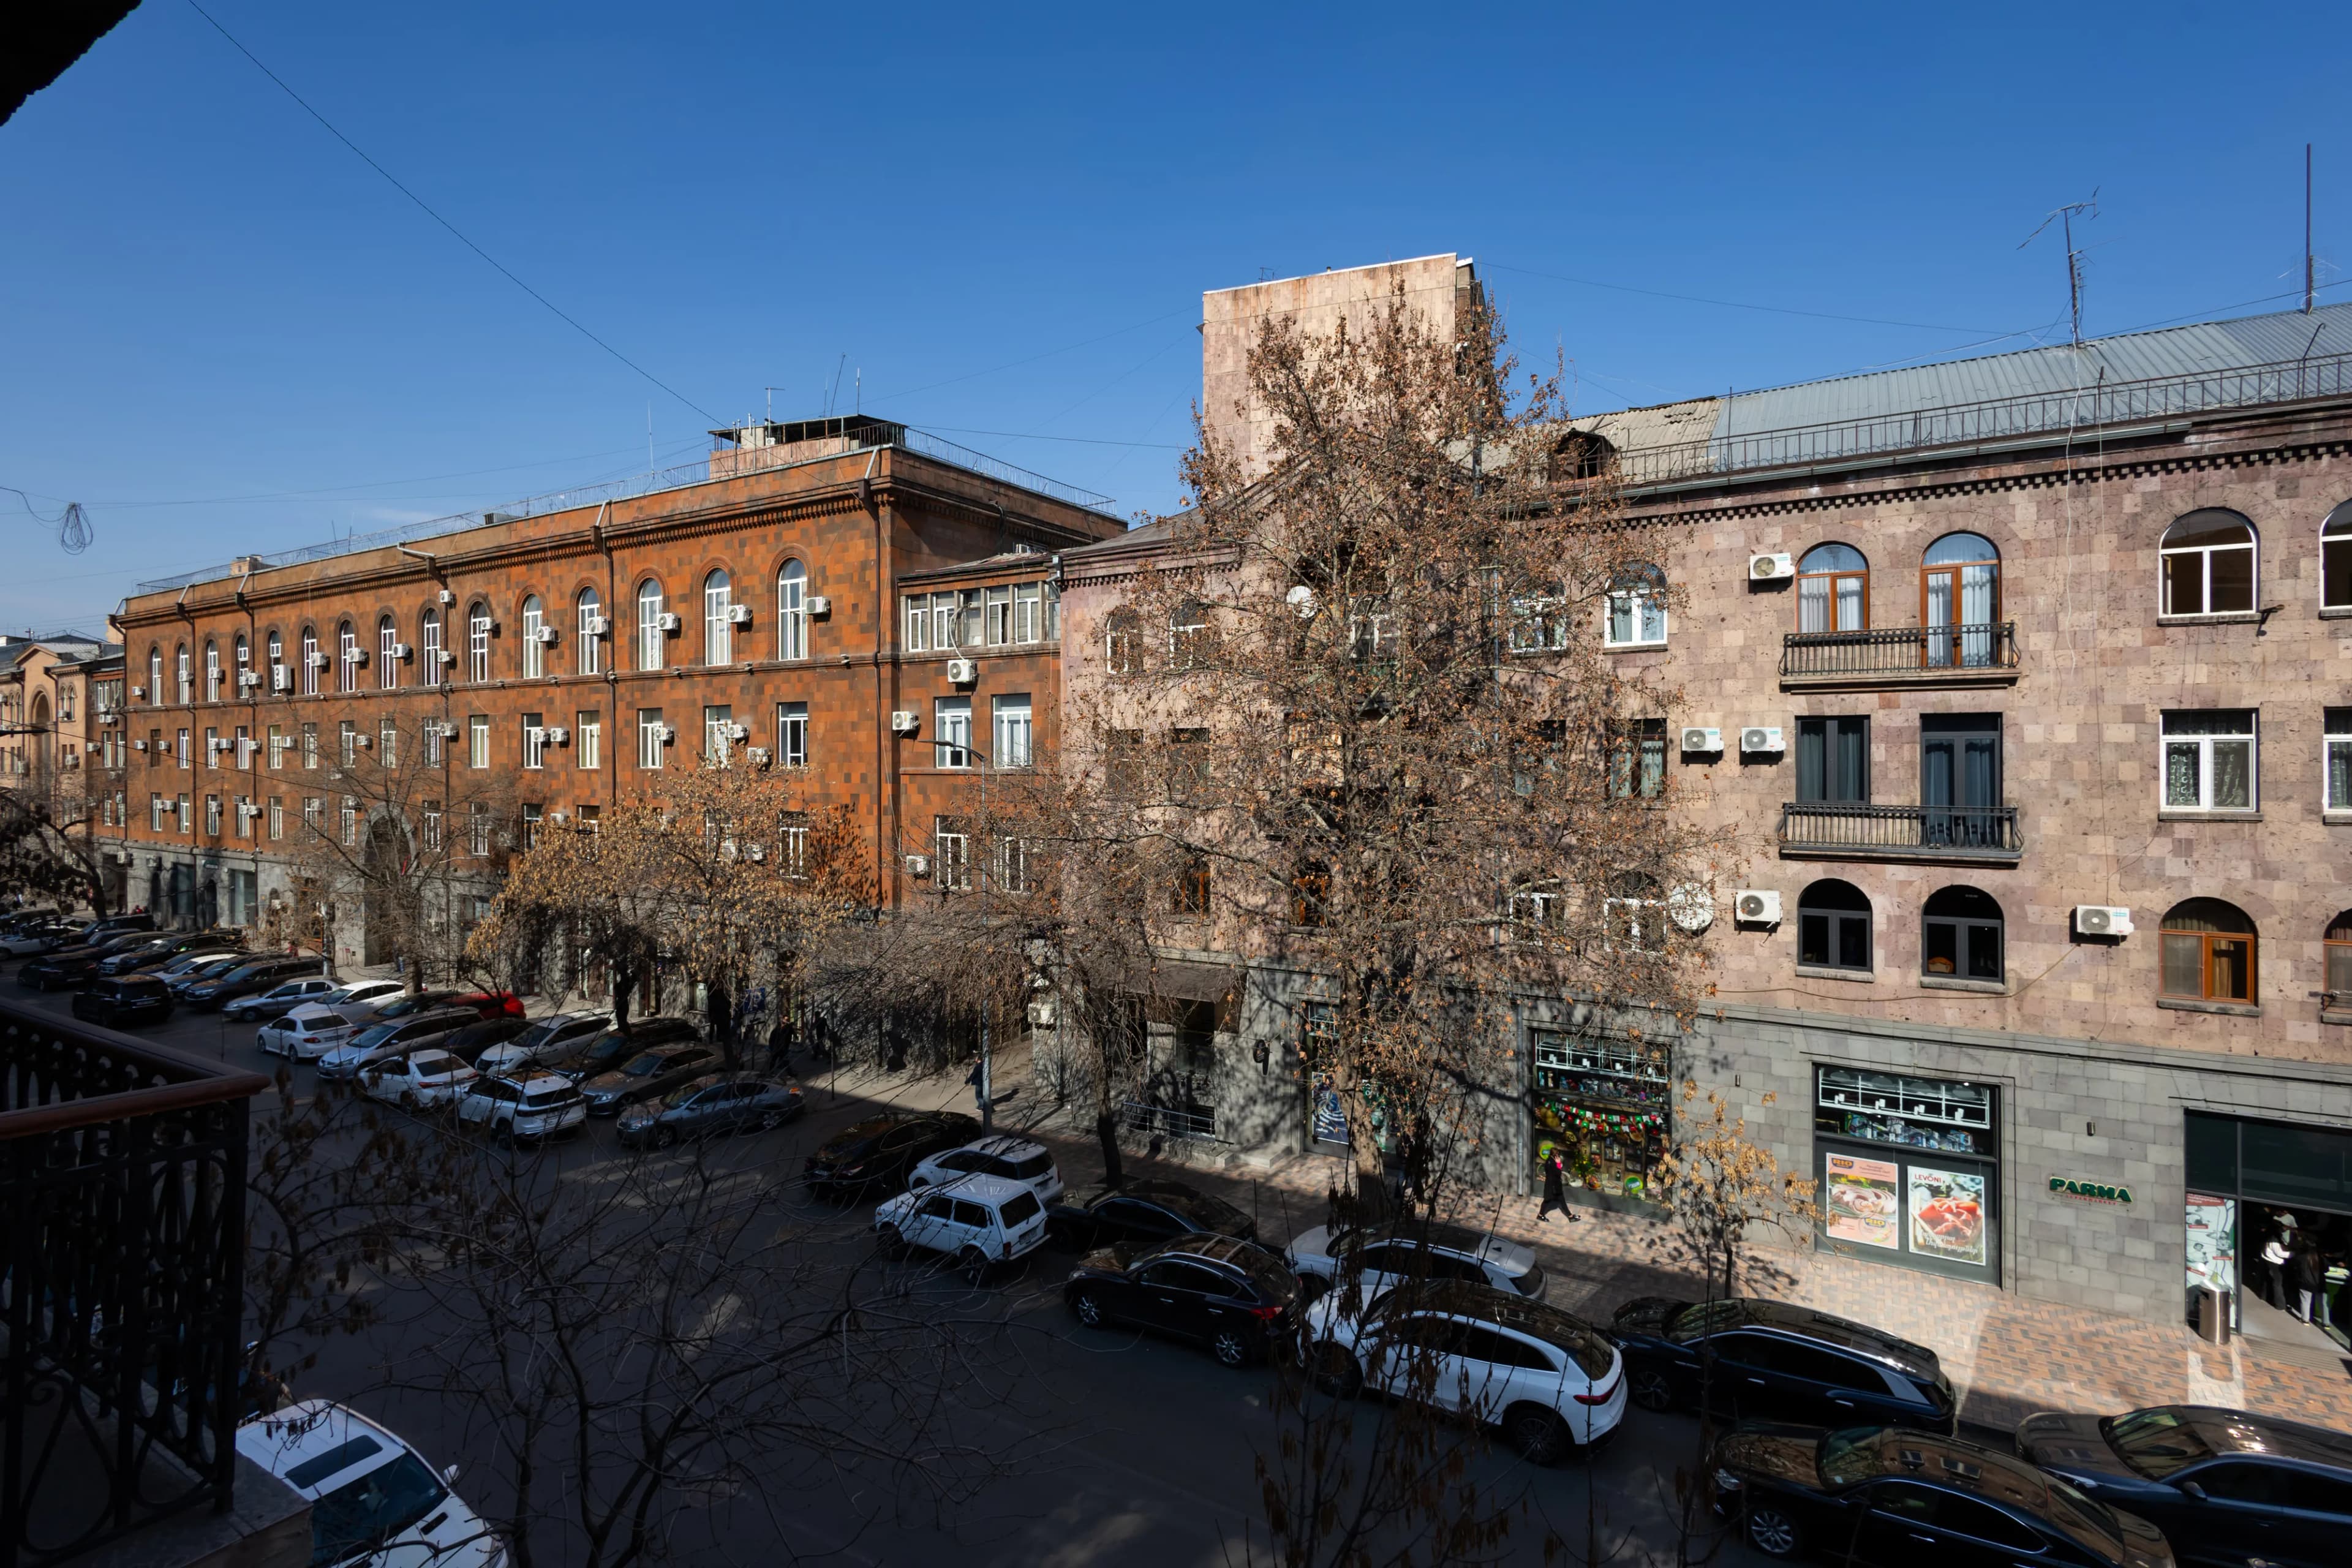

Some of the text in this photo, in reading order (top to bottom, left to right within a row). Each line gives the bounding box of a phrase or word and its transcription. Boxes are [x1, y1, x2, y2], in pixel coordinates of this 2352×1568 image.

[1914, 1174, 1942, 1183] LEVONI
[2049, 1176, 2133, 1202] PARMA
[1865, 1218, 1885, 1226] RIO
